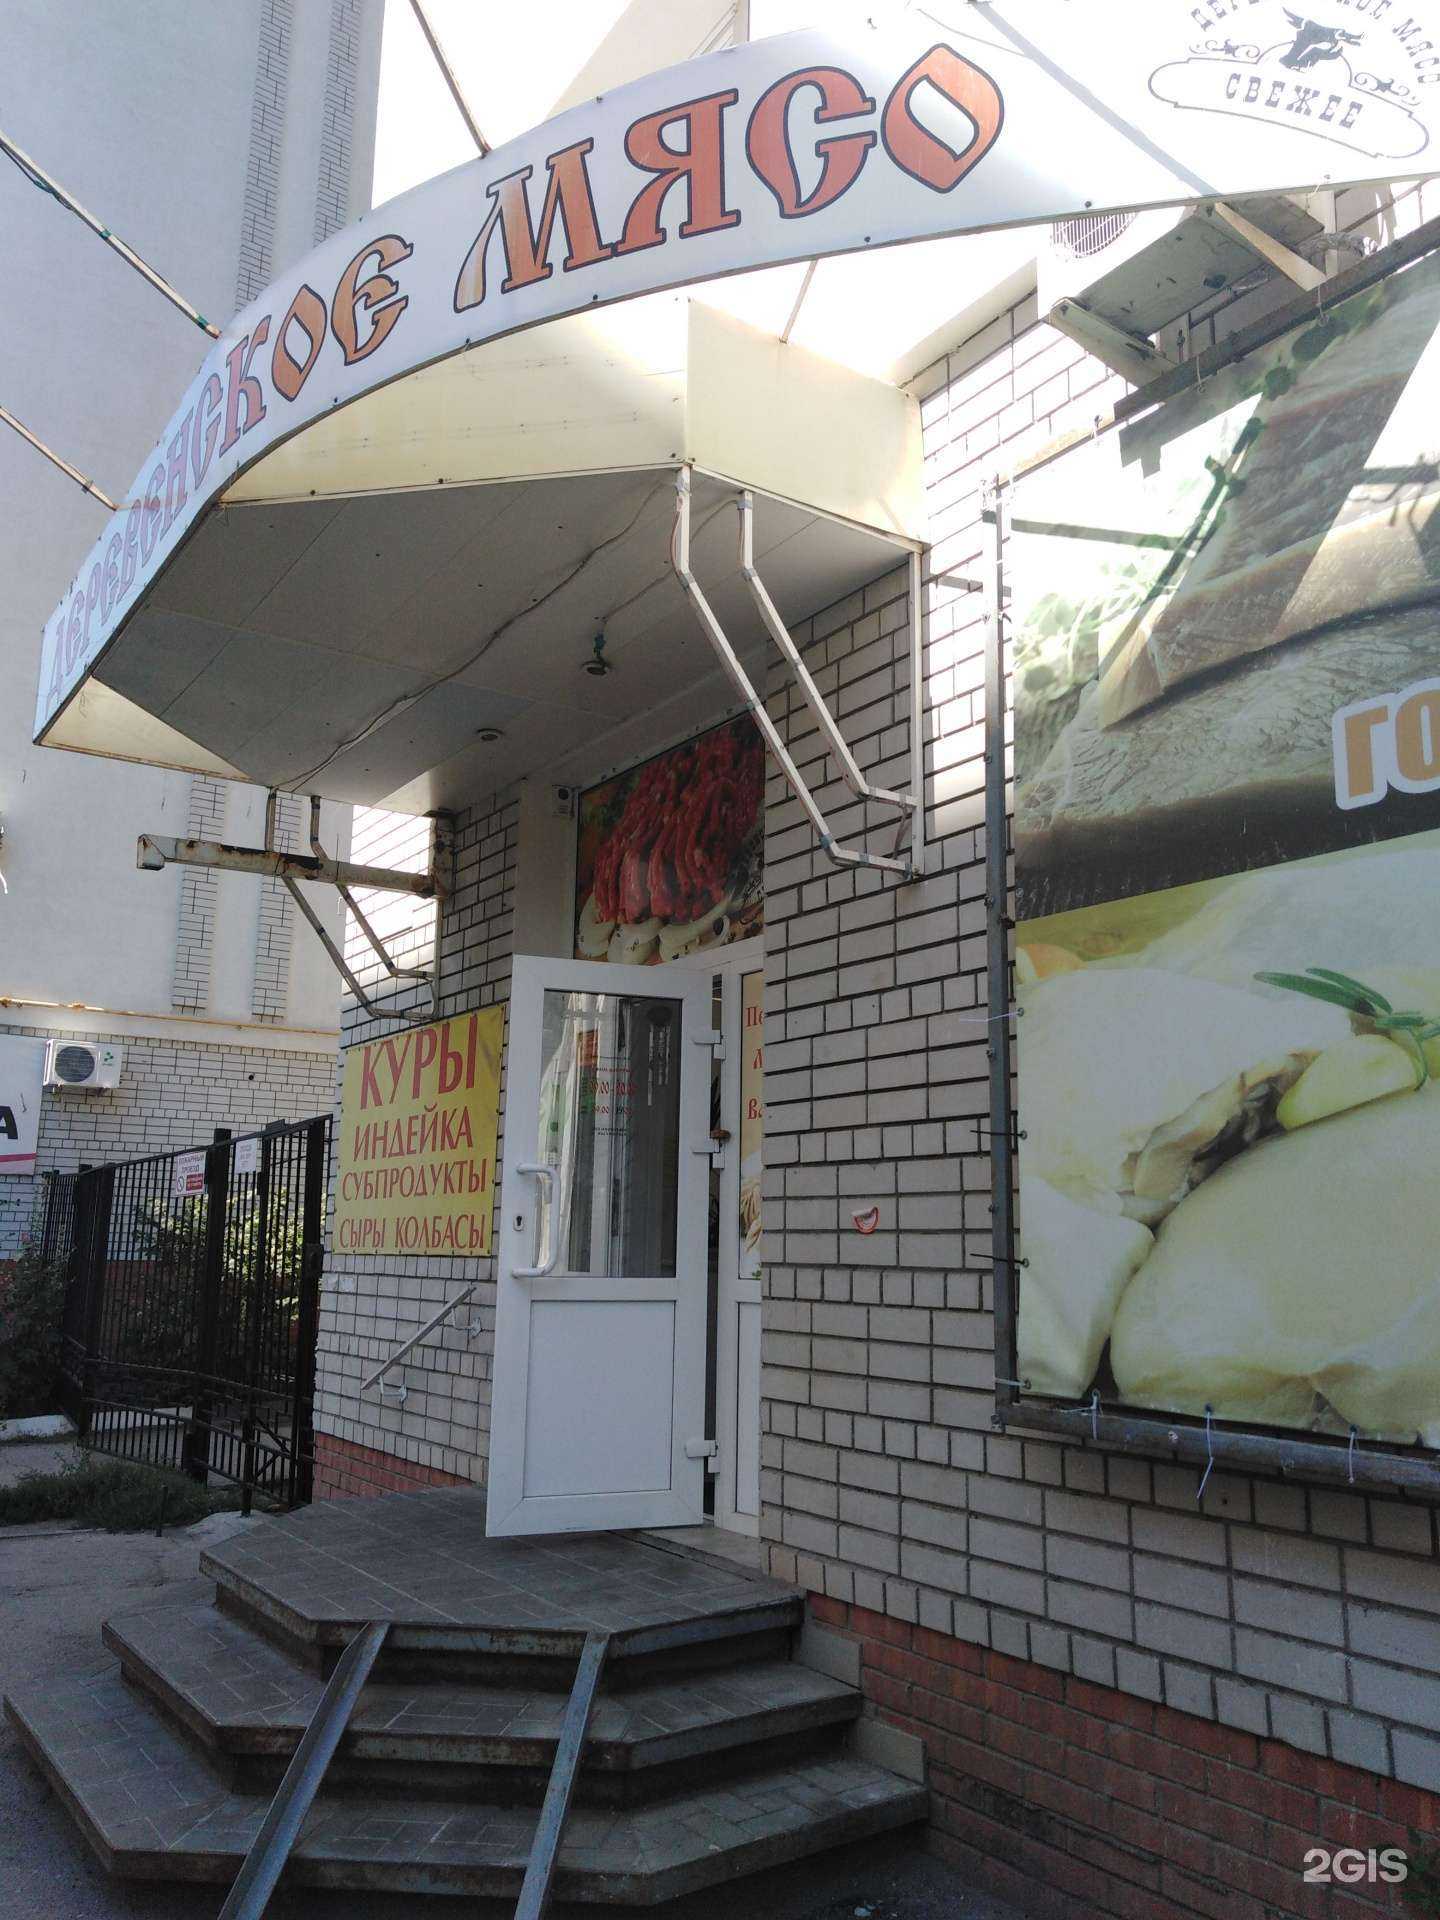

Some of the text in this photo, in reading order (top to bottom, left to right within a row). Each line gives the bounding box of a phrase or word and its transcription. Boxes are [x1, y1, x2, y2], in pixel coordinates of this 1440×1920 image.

[1225, 73, 1363, 129] СВЕЖЕЕ
[454, 43, 1005, 313] МЯСО
[360, 1014, 478, 1110] КУРЫ
[353, 1102, 473, 1162] ИНДЕЙКА
[342, 1159, 487, 1201] СУБПРОДУКТЫ
[339, 1214, 485, 1249] СЫРЫ КОЛБАСЫ
